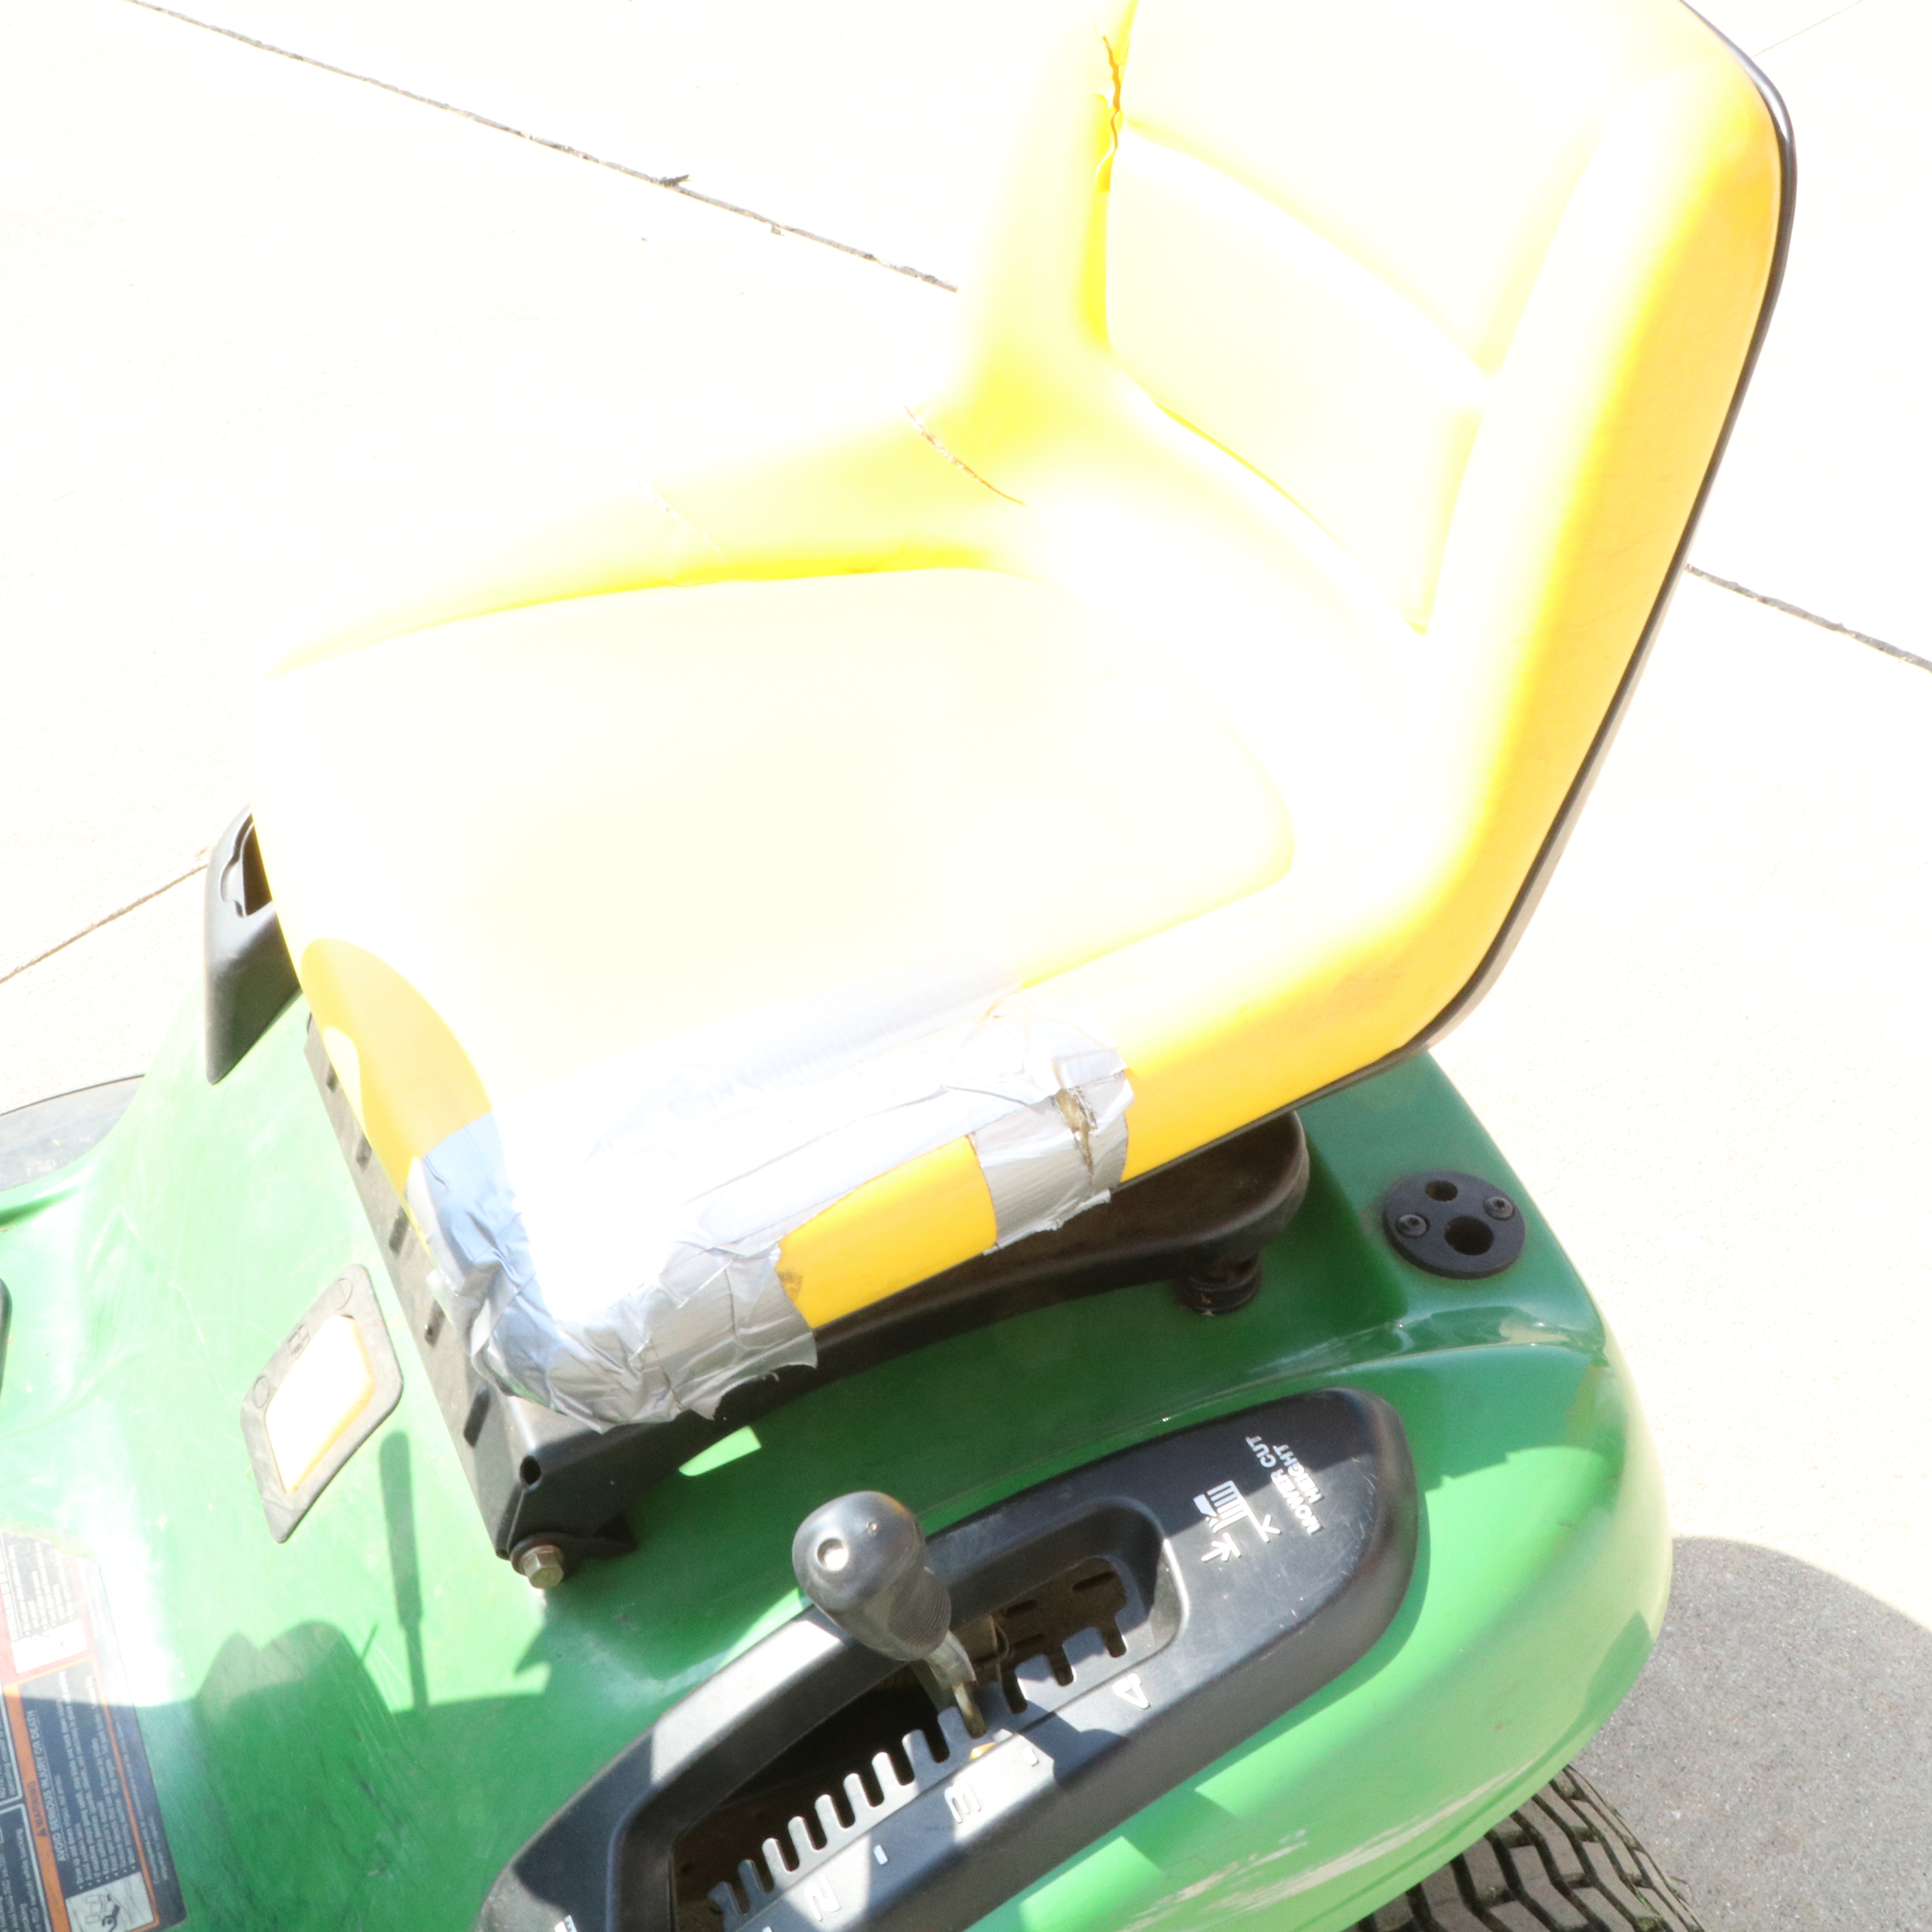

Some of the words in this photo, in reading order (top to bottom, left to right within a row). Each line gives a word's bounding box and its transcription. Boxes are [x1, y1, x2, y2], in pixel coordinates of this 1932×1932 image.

[1246, 1435, 1277, 1468] CUT
[1273, 1444, 1322, 1503] HEIGHT
[1270, 1469, 1322, 1534] MOWER
[1112, 1673, 1148, 1708] 4
[27, 1710, 39, 1740] DEATH
[33, 1742, 43, 1755] OR
[36, 1756, 49, 1788] INJURY
[28, 1781, 44, 1827] WARNING
[43, 1790, 58, 1831] SERIOUS
[944, 1780, 981, 1823] 3
[53, 1833, 67, 1861] AVOID
[804, 1873, 840, 1921] 2
